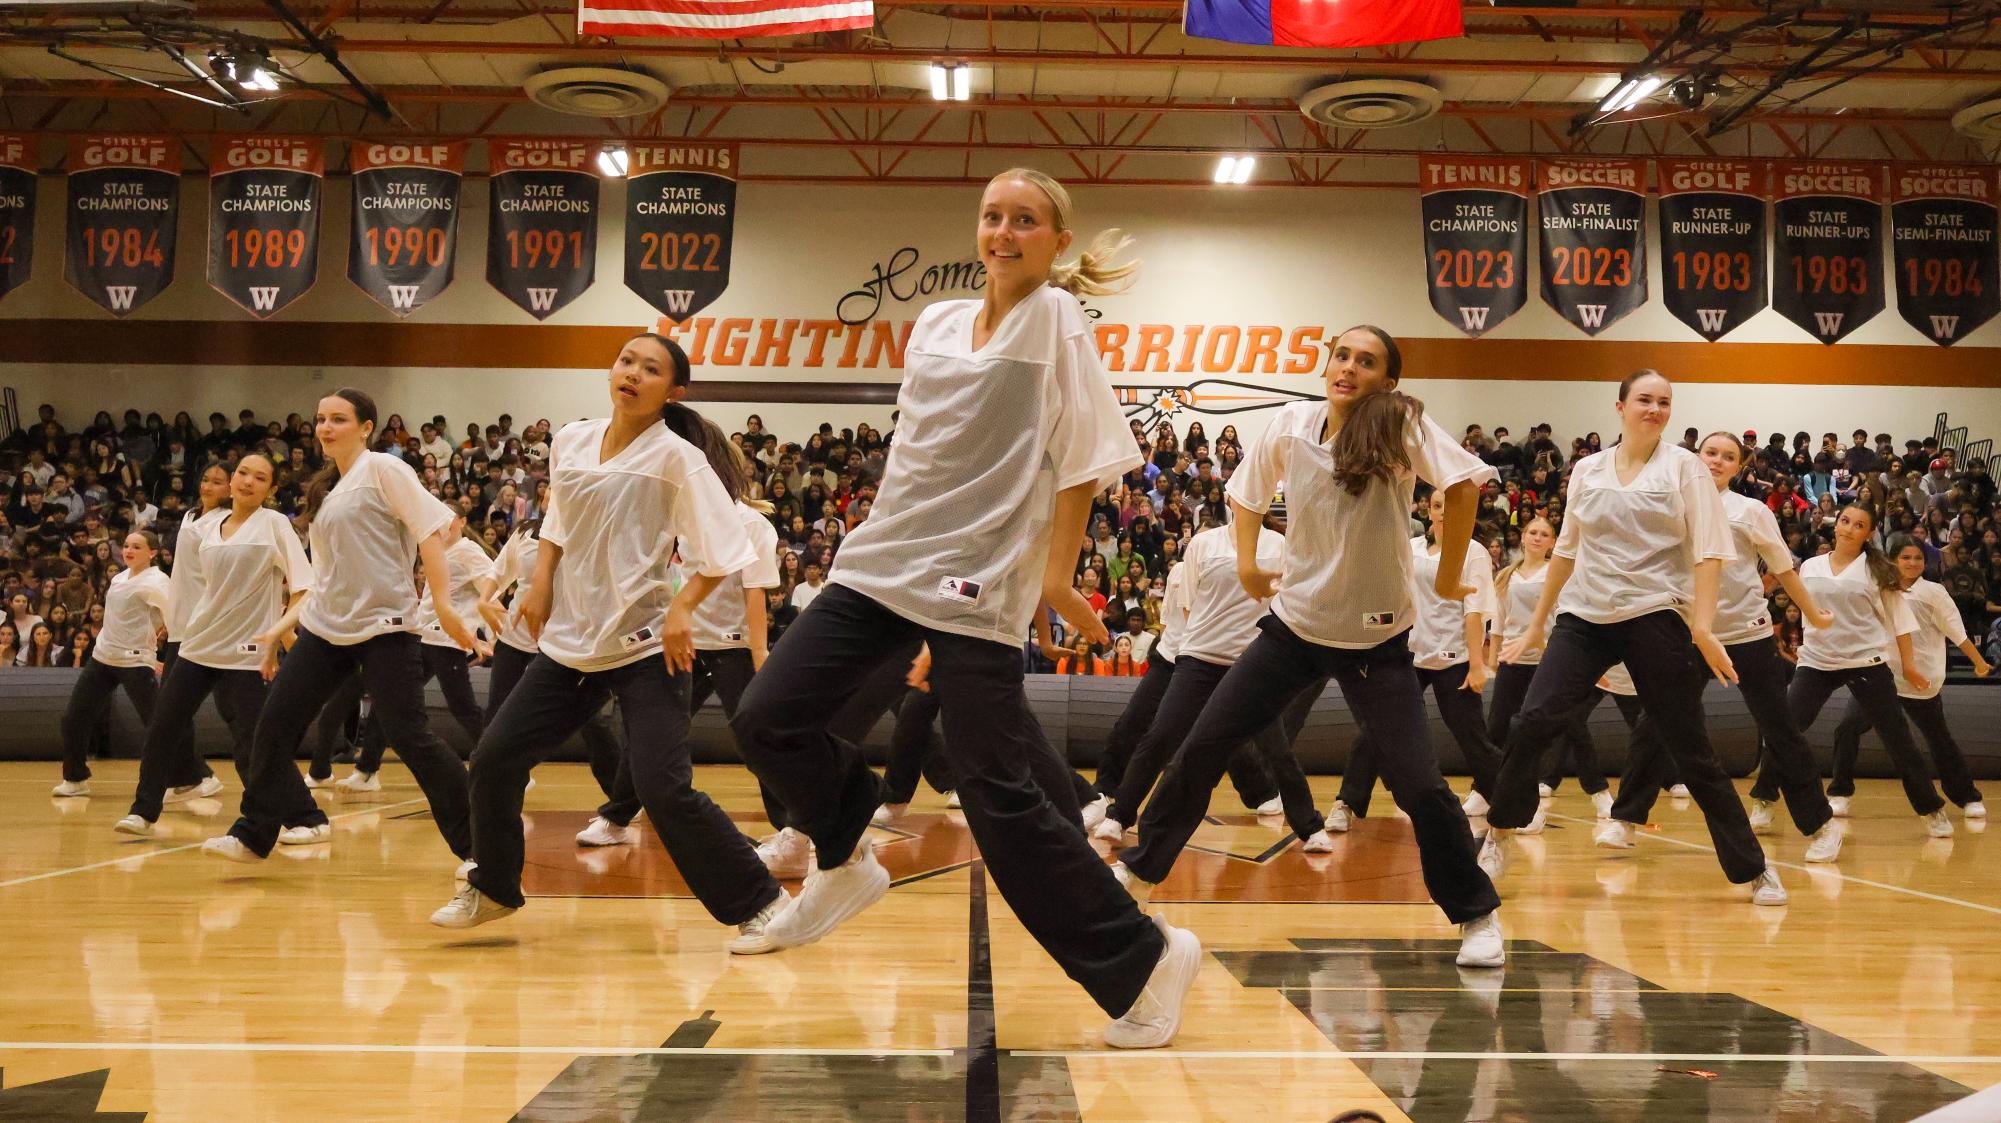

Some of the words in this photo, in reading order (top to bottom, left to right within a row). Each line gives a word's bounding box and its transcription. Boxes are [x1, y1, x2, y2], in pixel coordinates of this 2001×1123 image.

[104, 138, 148, 146] GIRLS
[246, 138, 290, 147] GIRLS
[84, 146, 166, 166] GOLF
[227, 147, 308, 167] GOLF
[368, 144, 448, 165] GOLF
[505, 149, 586, 168] GOLF
[636, 148, 730, 169] TENNIS
[1428, 164, 1522, 187] TENNIS
[1548, 166, 1636, 187] SOCCER
[1690, 162, 1733, 171] GIRLS
[1806, 166, 1849, 174] GIRLS
[1922, 168, 1965, 177] GIRLS
[104, 183, 144, 195] STATE
[246, 184, 287, 197] STATE
[386, 183, 427, 195] STATE
[524, 184, 565, 197] STATE
[1672, 171, 1751, 191] GOLF
[1784, 174, 1872, 195] SOCCER
[1900, 178, 1987, 197] SOCCER
[662, 187, 702, 200] STATE
[78, 198, 169, 211] CHAMPIONS
[222, 198, 311, 212] CHAMPIONS
[362, 197, 452, 211] CHAMPIONS
[500, 200, 590, 213] CHAMPIONS
[636, 202, 727, 216] CHAMPIONS
[1456, 204, 1495, 217] STATE
[1572, 203, 1611, 216] STATE
[1692, 208, 1732, 220] STATE
[1430, 220, 1518, 233] CHAMPIONS
[1544, 216, 1640, 231] SEMI-FINALIST
[1808, 211, 1848, 224] STATE
[1924, 214, 1964, 226] STATE
[1672, 222, 1752, 235] RUNNER-UP
[1786, 225, 1871, 239] RUNNER-UPS
[1896, 228, 1993, 242] SEMI-FINALIST
[84, 228, 164, 268] 1984
[226, 229, 305, 268] 1989
[366, 226, 446, 268] 1990
[506, 229, 583, 269] 1991
[640, 232, 721, 272] 2022
[1434, 248, 1514, 289] 2023
[1552, 246, 1632, 287] 2023
[1672, 252, 1751, 291] 1983
[1792, 256, 1868, 295] 1983
[836, 248, 988, 325] Home
[1904, 258, 1984, 297] 1984
[106, 286, 137, 310] W
[249, 287, 280, 311] W
[388, 286, 420, 309] W
[526, 288, 558, 311] W
[664, 290, 696, 313] W
[1459, 307, 1490, 330] W
[1576, 304, 1607, 328] W
[1696, 310, 1727, 332] W
[1814, 313, 1845, 336] W
[1928, 316, 1961, 339] W
[656, 317, 916, 368] FIGHTIN
[1093, 324, 1325, 374] RRIORS
